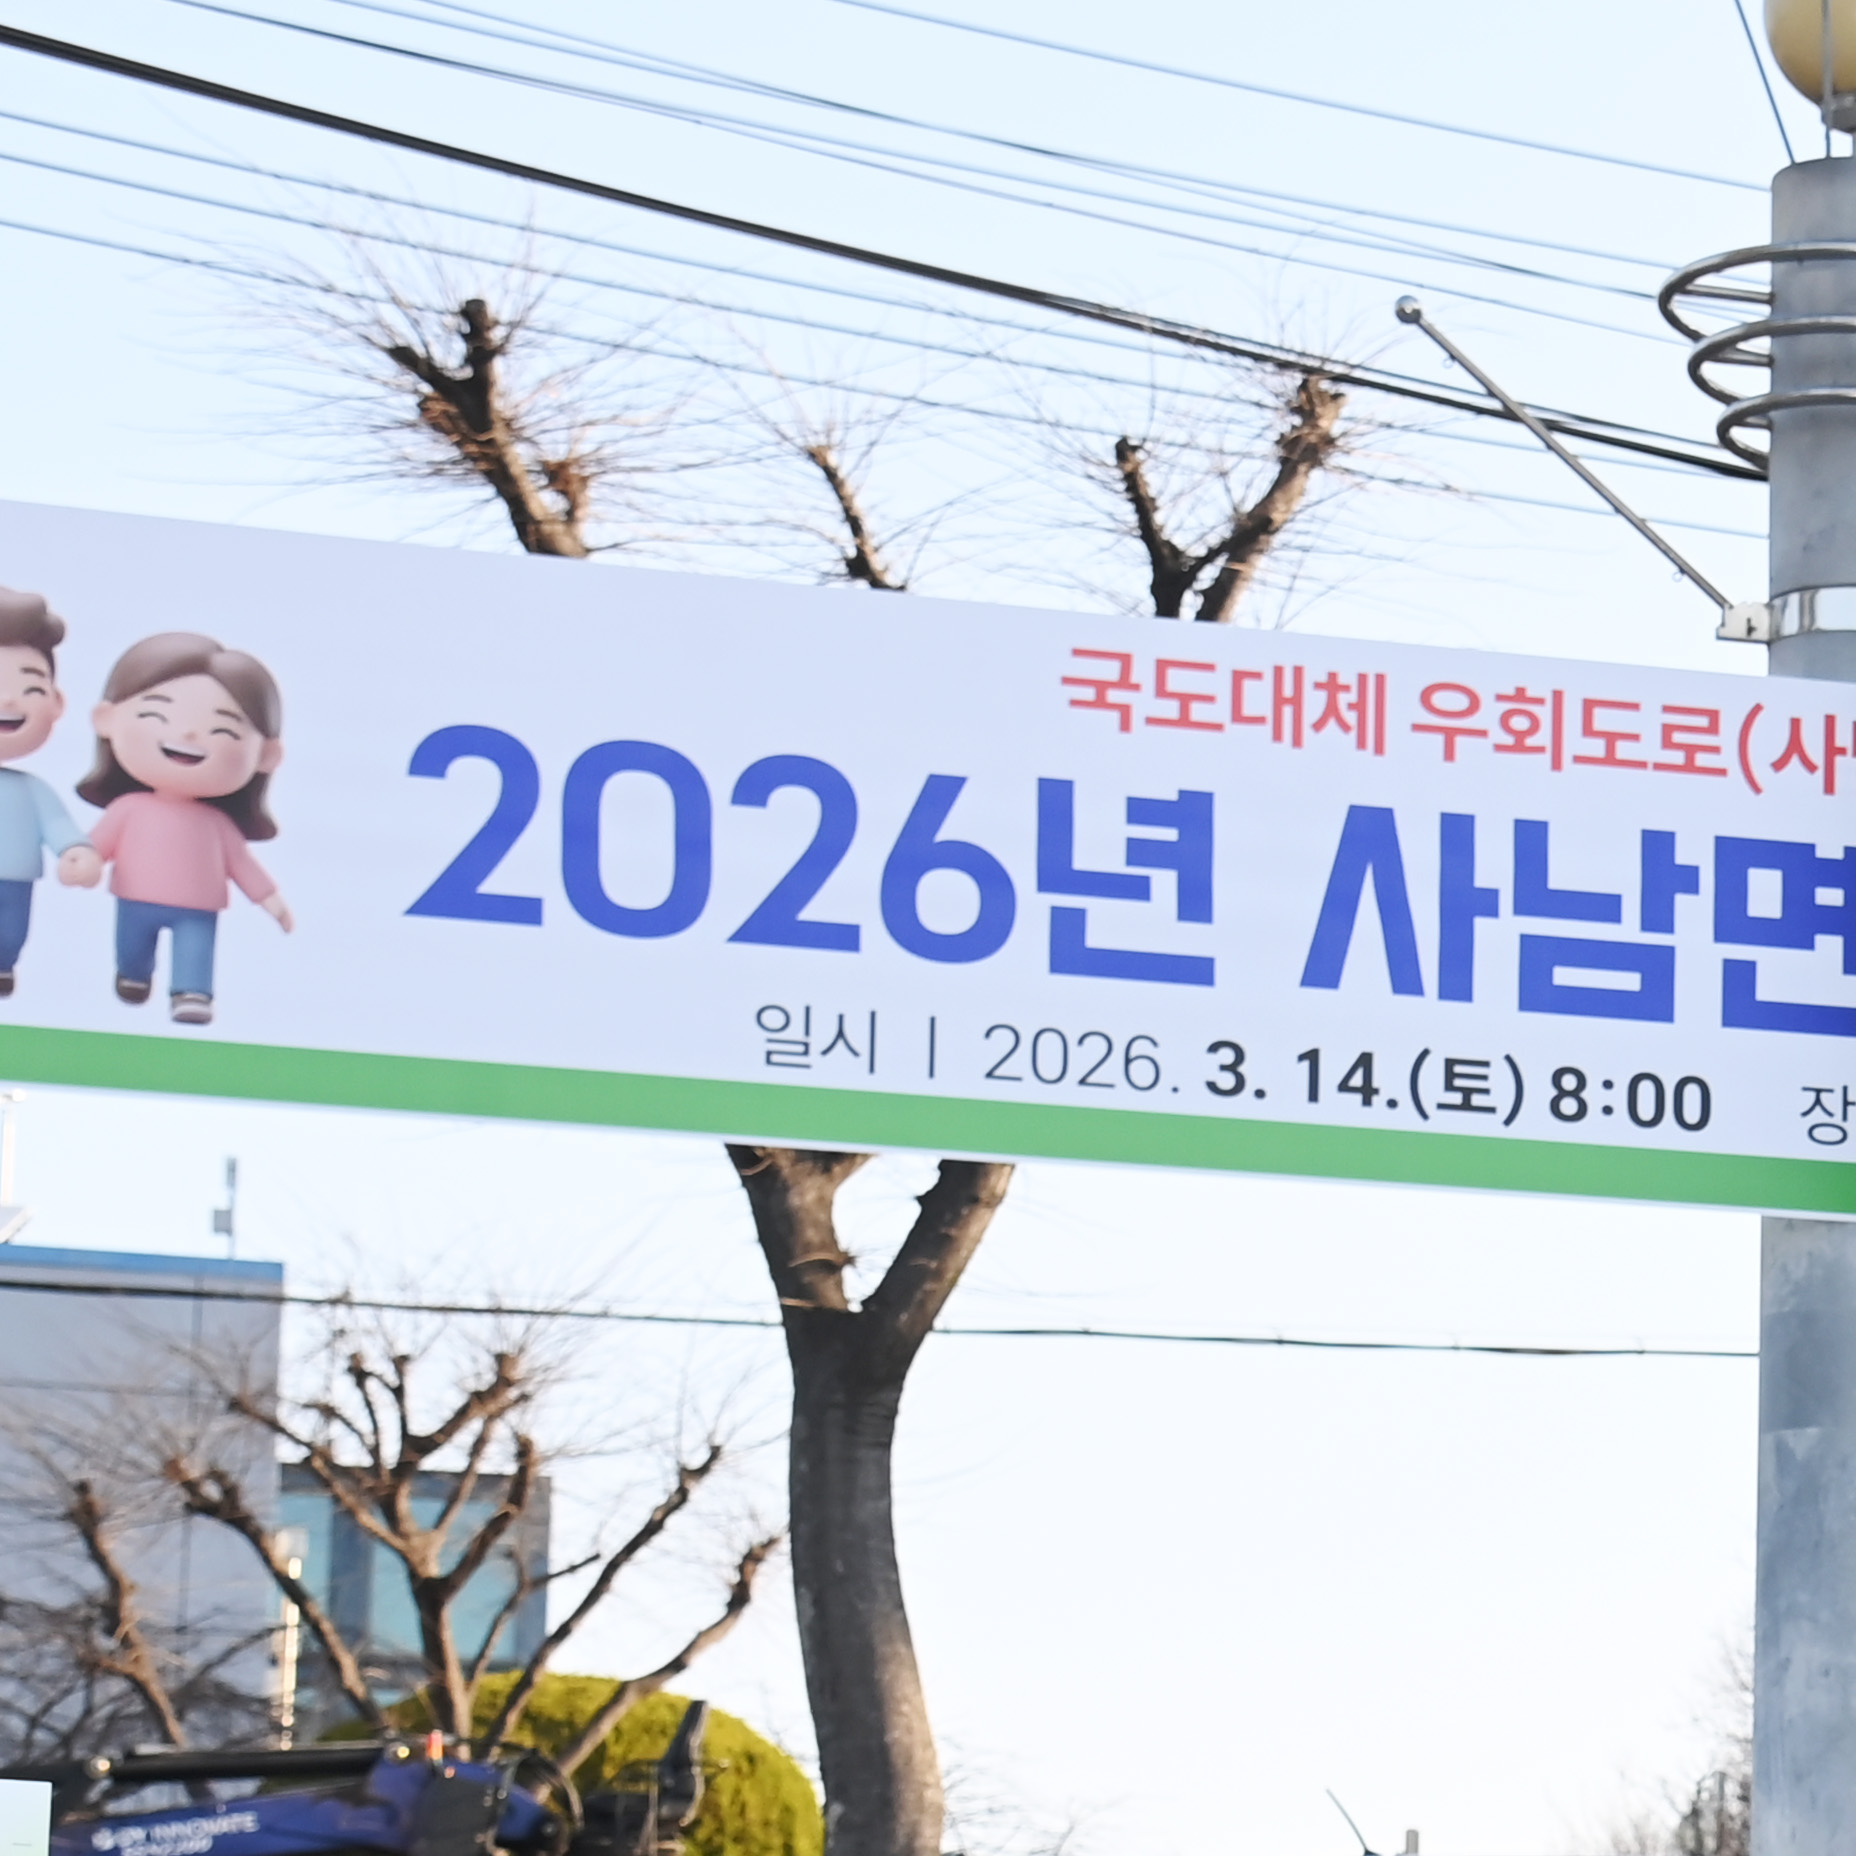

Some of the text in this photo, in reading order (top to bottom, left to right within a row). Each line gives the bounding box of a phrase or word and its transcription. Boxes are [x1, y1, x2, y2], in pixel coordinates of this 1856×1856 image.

[1060, 647, 1388, 756] 국도대체
[404, 724, 1216, 988] 2026년
[755, 1004, 877, 1075] 일시
[1549, 1066, 1712, 1132] 8:00
